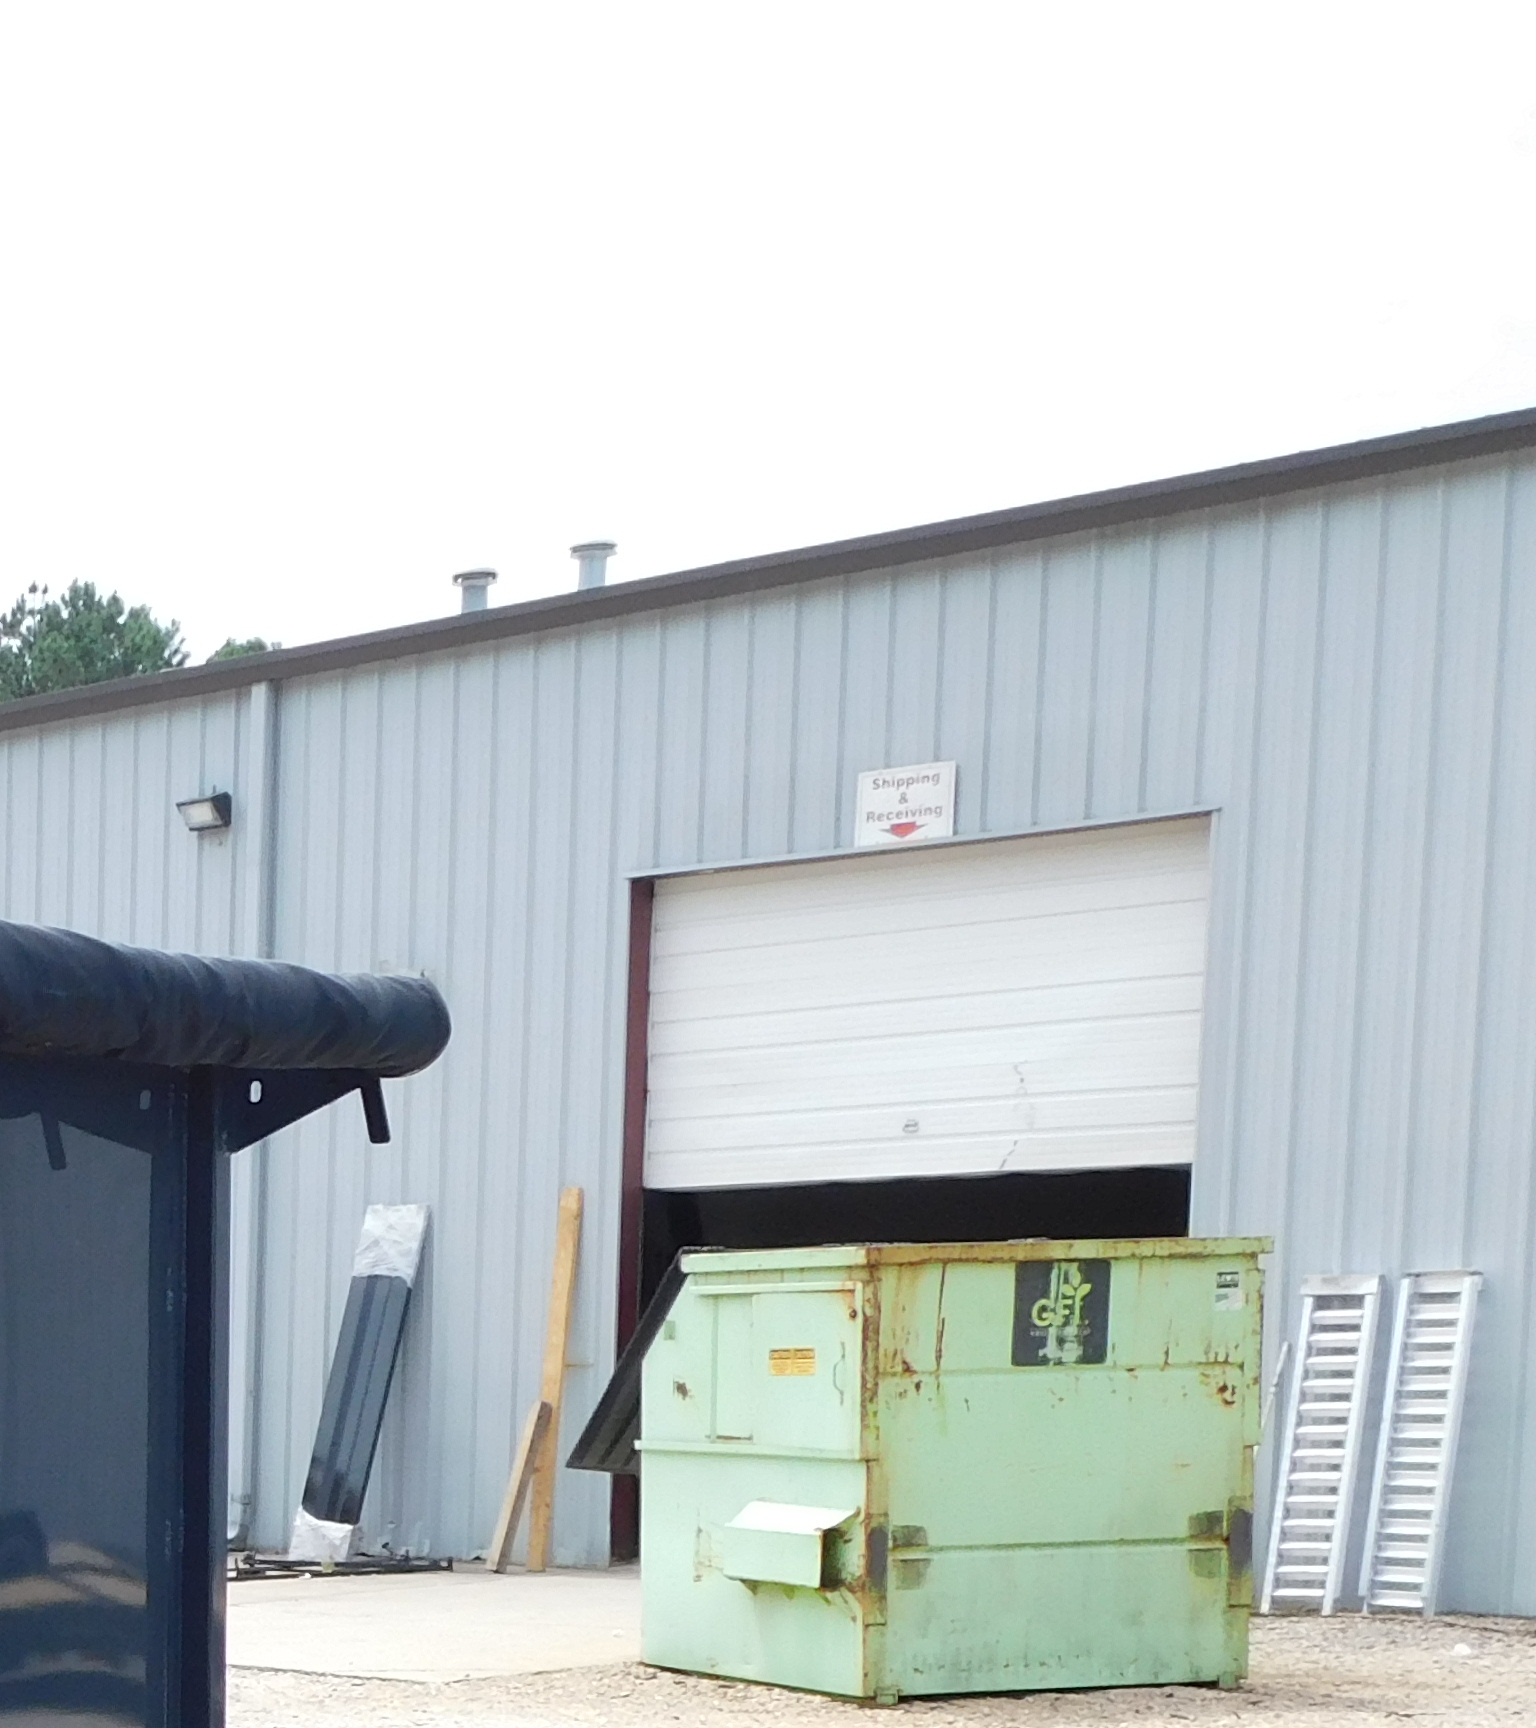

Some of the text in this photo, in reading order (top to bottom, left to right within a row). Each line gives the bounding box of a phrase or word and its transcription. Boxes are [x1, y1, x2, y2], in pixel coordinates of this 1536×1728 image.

[872, 772, 941, 790] Shipping
[898, 792, 909, 804] &
[866, 804, 943, 823] Receiving
